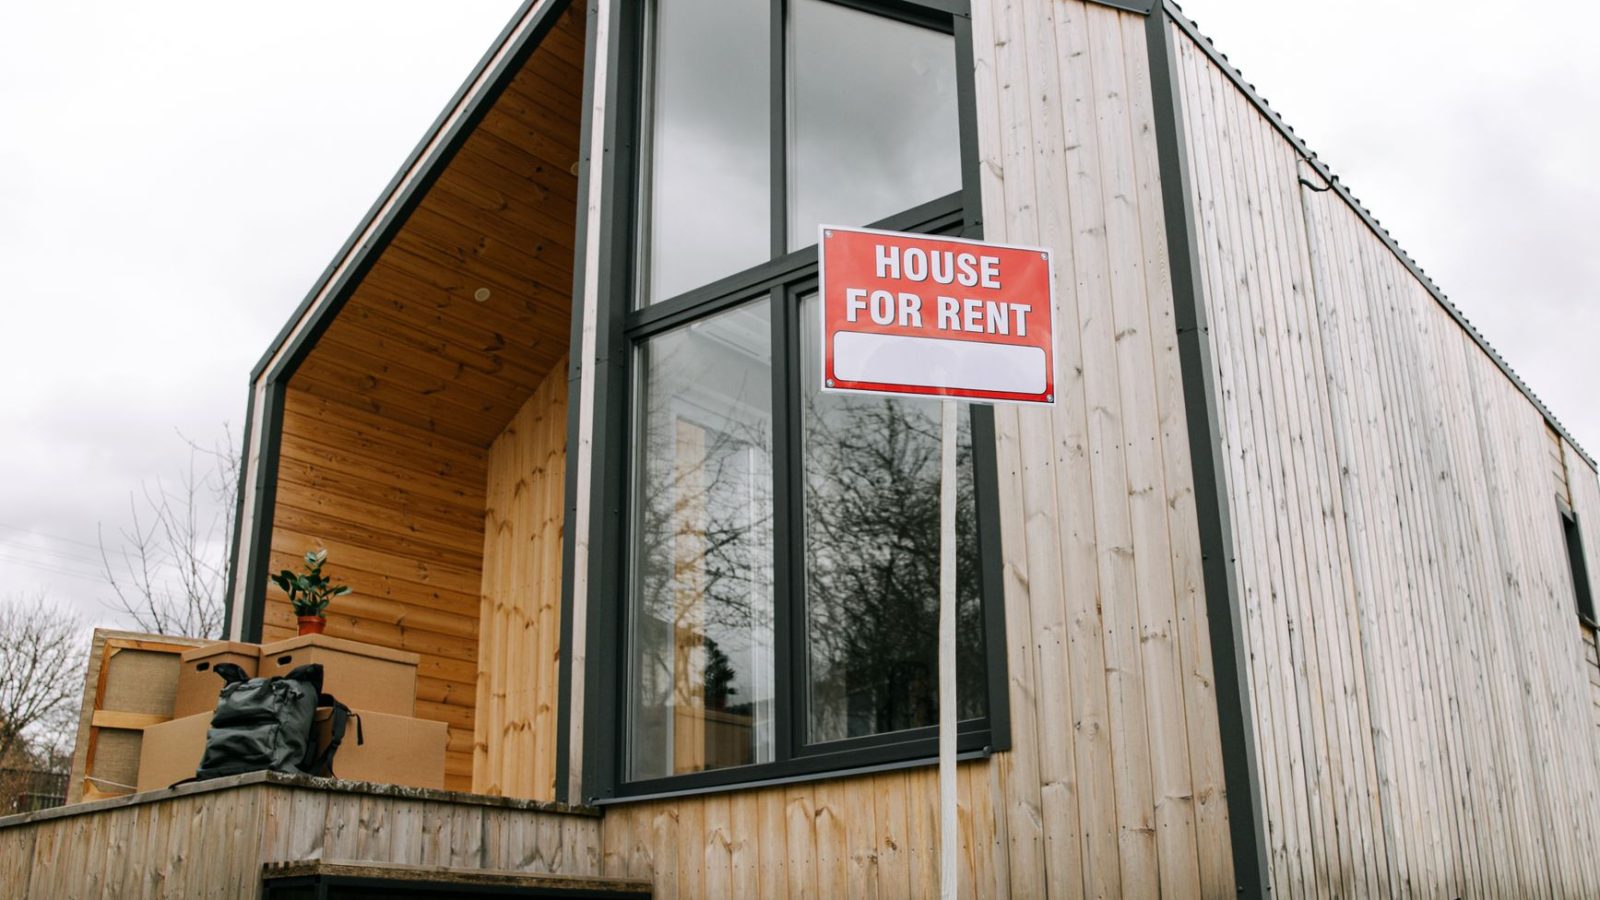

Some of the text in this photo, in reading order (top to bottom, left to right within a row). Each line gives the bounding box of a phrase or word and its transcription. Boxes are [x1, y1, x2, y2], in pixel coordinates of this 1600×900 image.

[875, 244, 1001, 289] HOUSE
[846, 287, 1031, 337] FOR RENT
